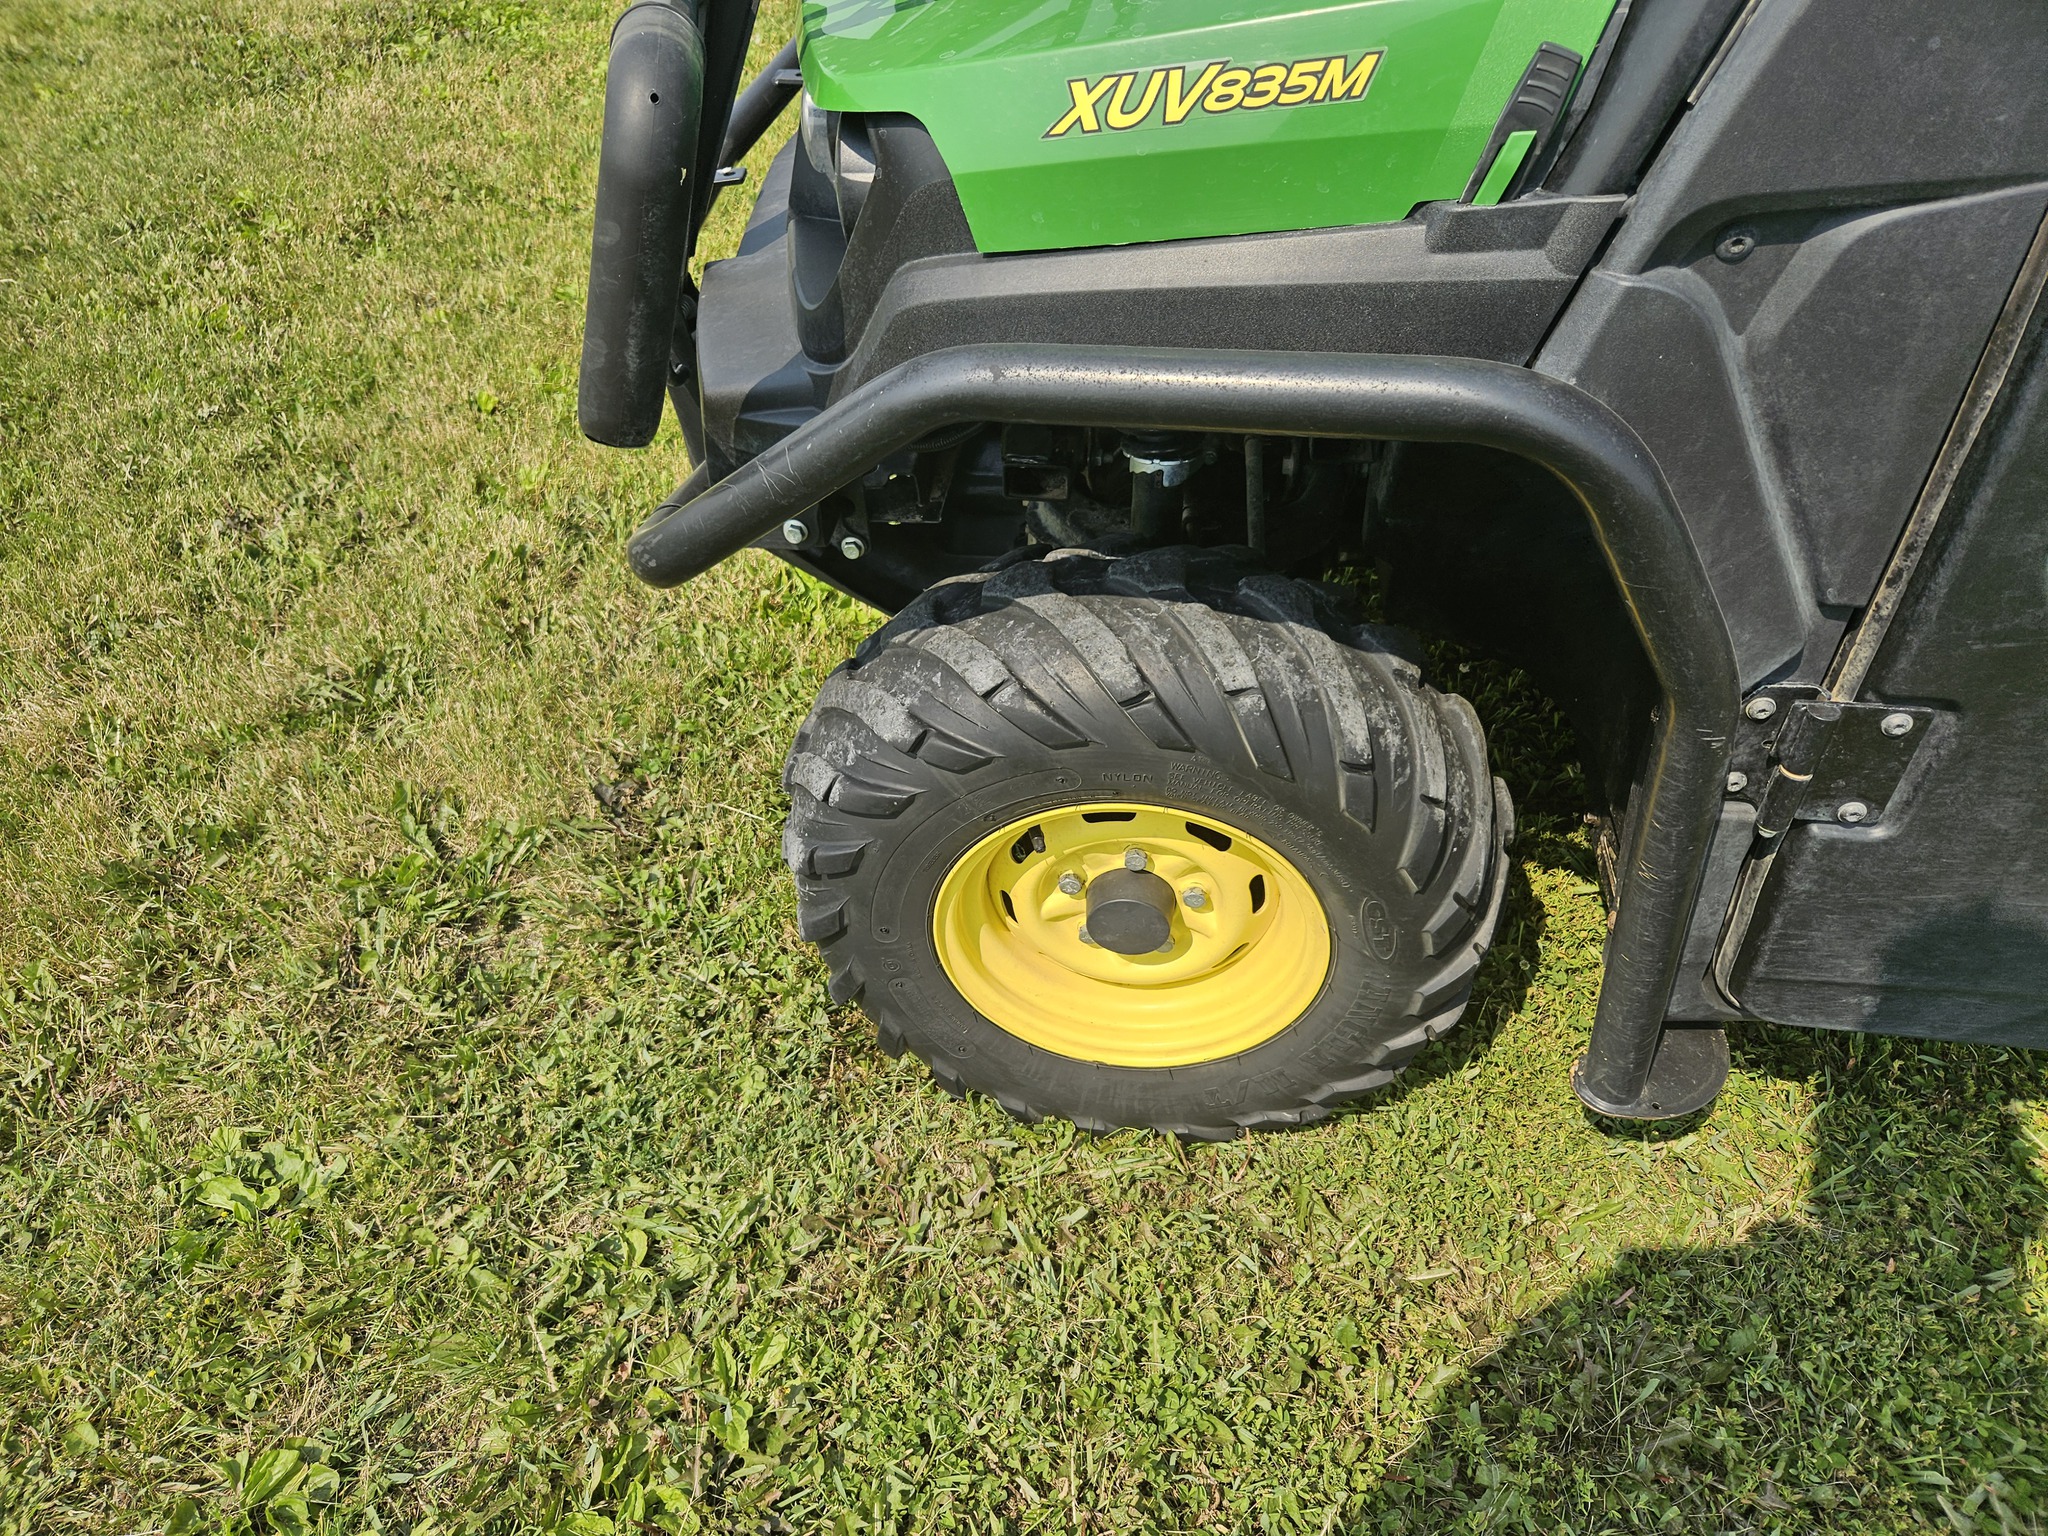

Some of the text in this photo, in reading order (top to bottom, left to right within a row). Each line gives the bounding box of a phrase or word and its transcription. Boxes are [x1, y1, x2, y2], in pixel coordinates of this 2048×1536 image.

[1041, 50, 1385, 139] XUV835M
[1101, 772, 1153, 782] NYLON
[1366, 901, 1392, 953] CST
